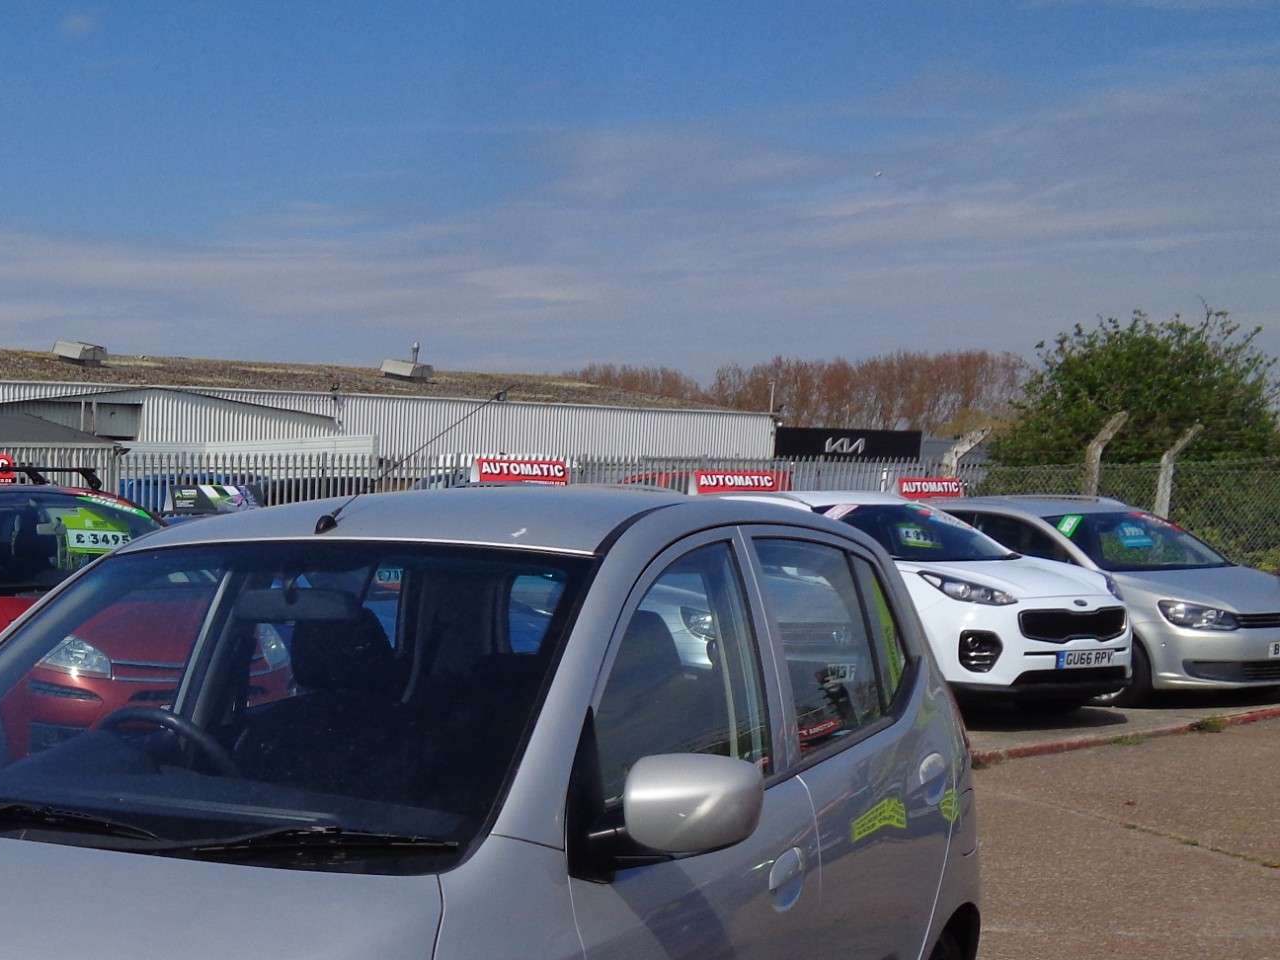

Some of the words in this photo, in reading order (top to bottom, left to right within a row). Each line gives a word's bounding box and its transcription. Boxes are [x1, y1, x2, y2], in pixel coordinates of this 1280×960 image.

[481, 461, 564, 477] AUTOMATIC
[699, 473, 773, 487] AUTOMATIC
[903, 481, 959, 492] AUTOMATIC
[1066, 652, 1093, 665] GU66
[1094, 651, 1113, 664] RPV
